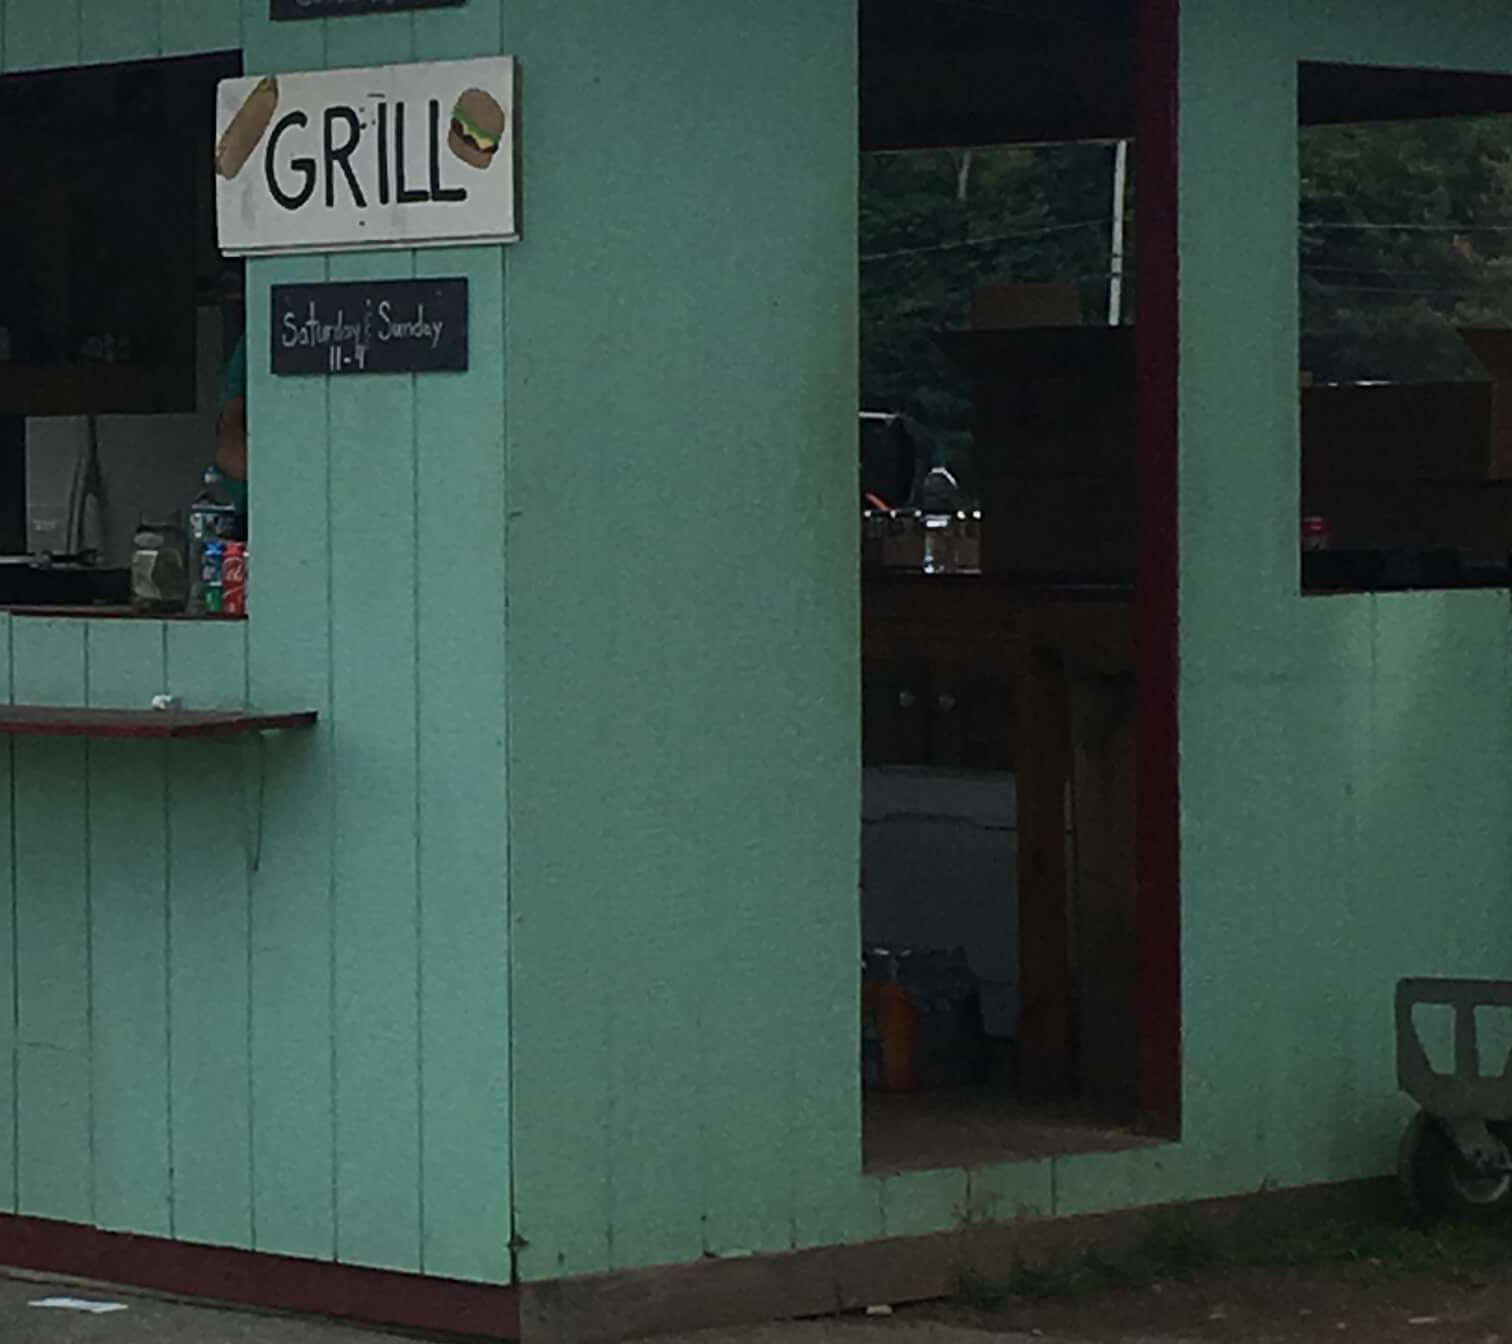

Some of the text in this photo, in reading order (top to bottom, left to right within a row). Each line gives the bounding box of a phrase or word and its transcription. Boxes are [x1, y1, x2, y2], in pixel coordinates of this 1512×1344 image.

[265, 99, 467, 211] GRILL
[282, 300, 361, 348] Saturday
[377, 299, 444, 349] Sunday
